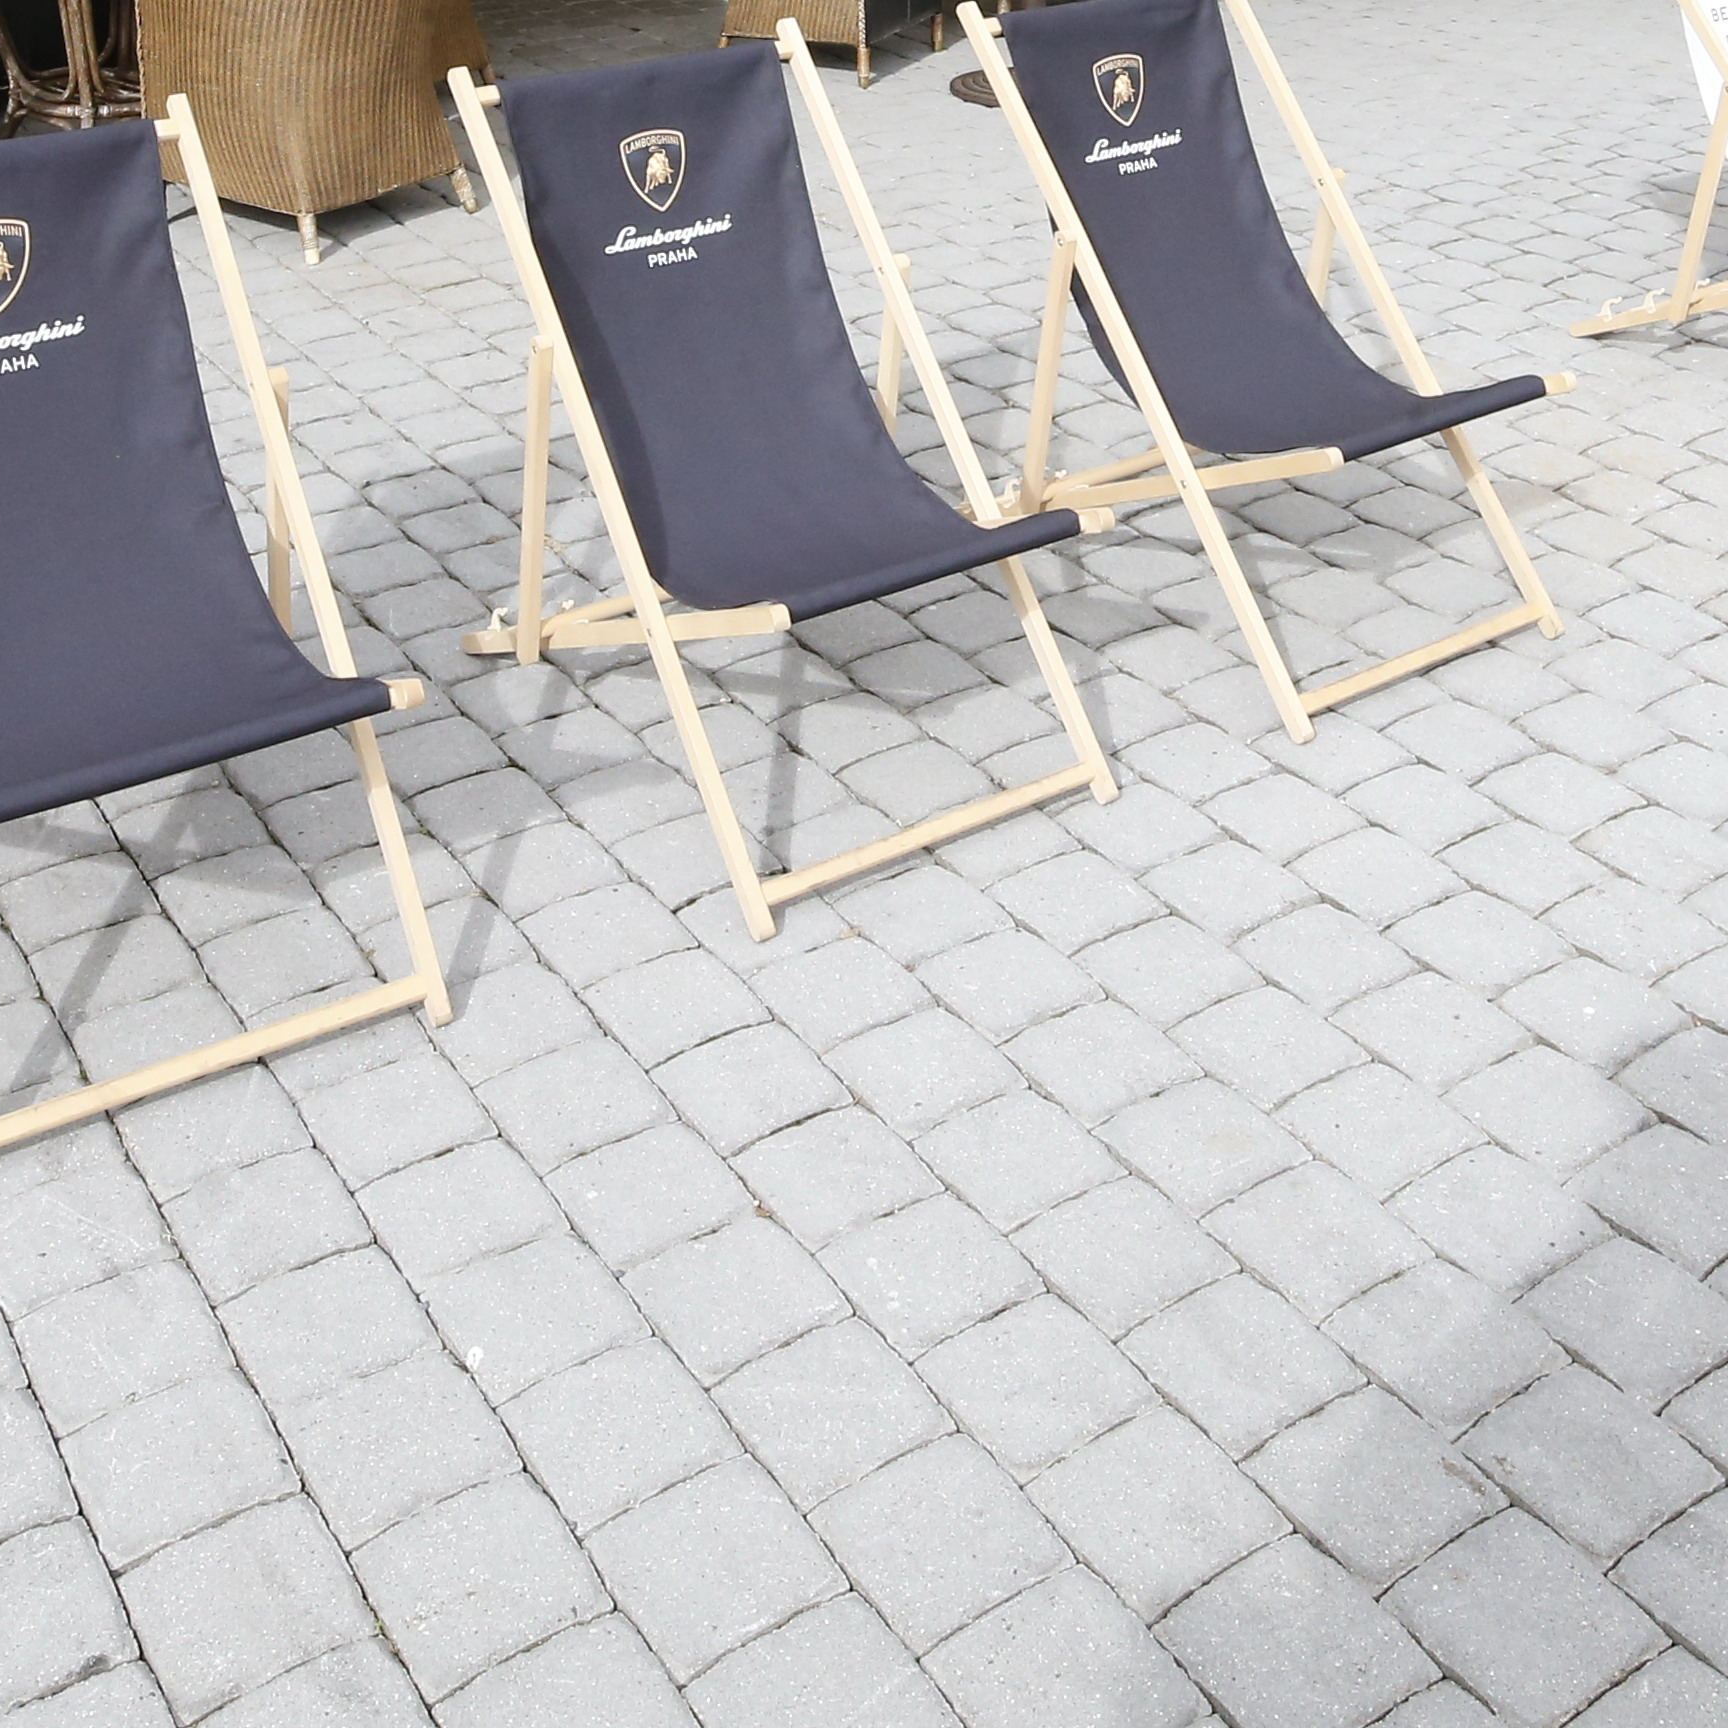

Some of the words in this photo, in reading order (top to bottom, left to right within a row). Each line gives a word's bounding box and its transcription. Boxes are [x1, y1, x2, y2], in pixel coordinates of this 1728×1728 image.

[625, 135, 679, 154] LAMBORGHINI
[1085, 128, 1182, 163] Lamborghini
[1118, 157, 1158, 175] PRAHA
[604, 213, 732, 255] Lamborghini
[647, 246, 698, 268] PRAHA
